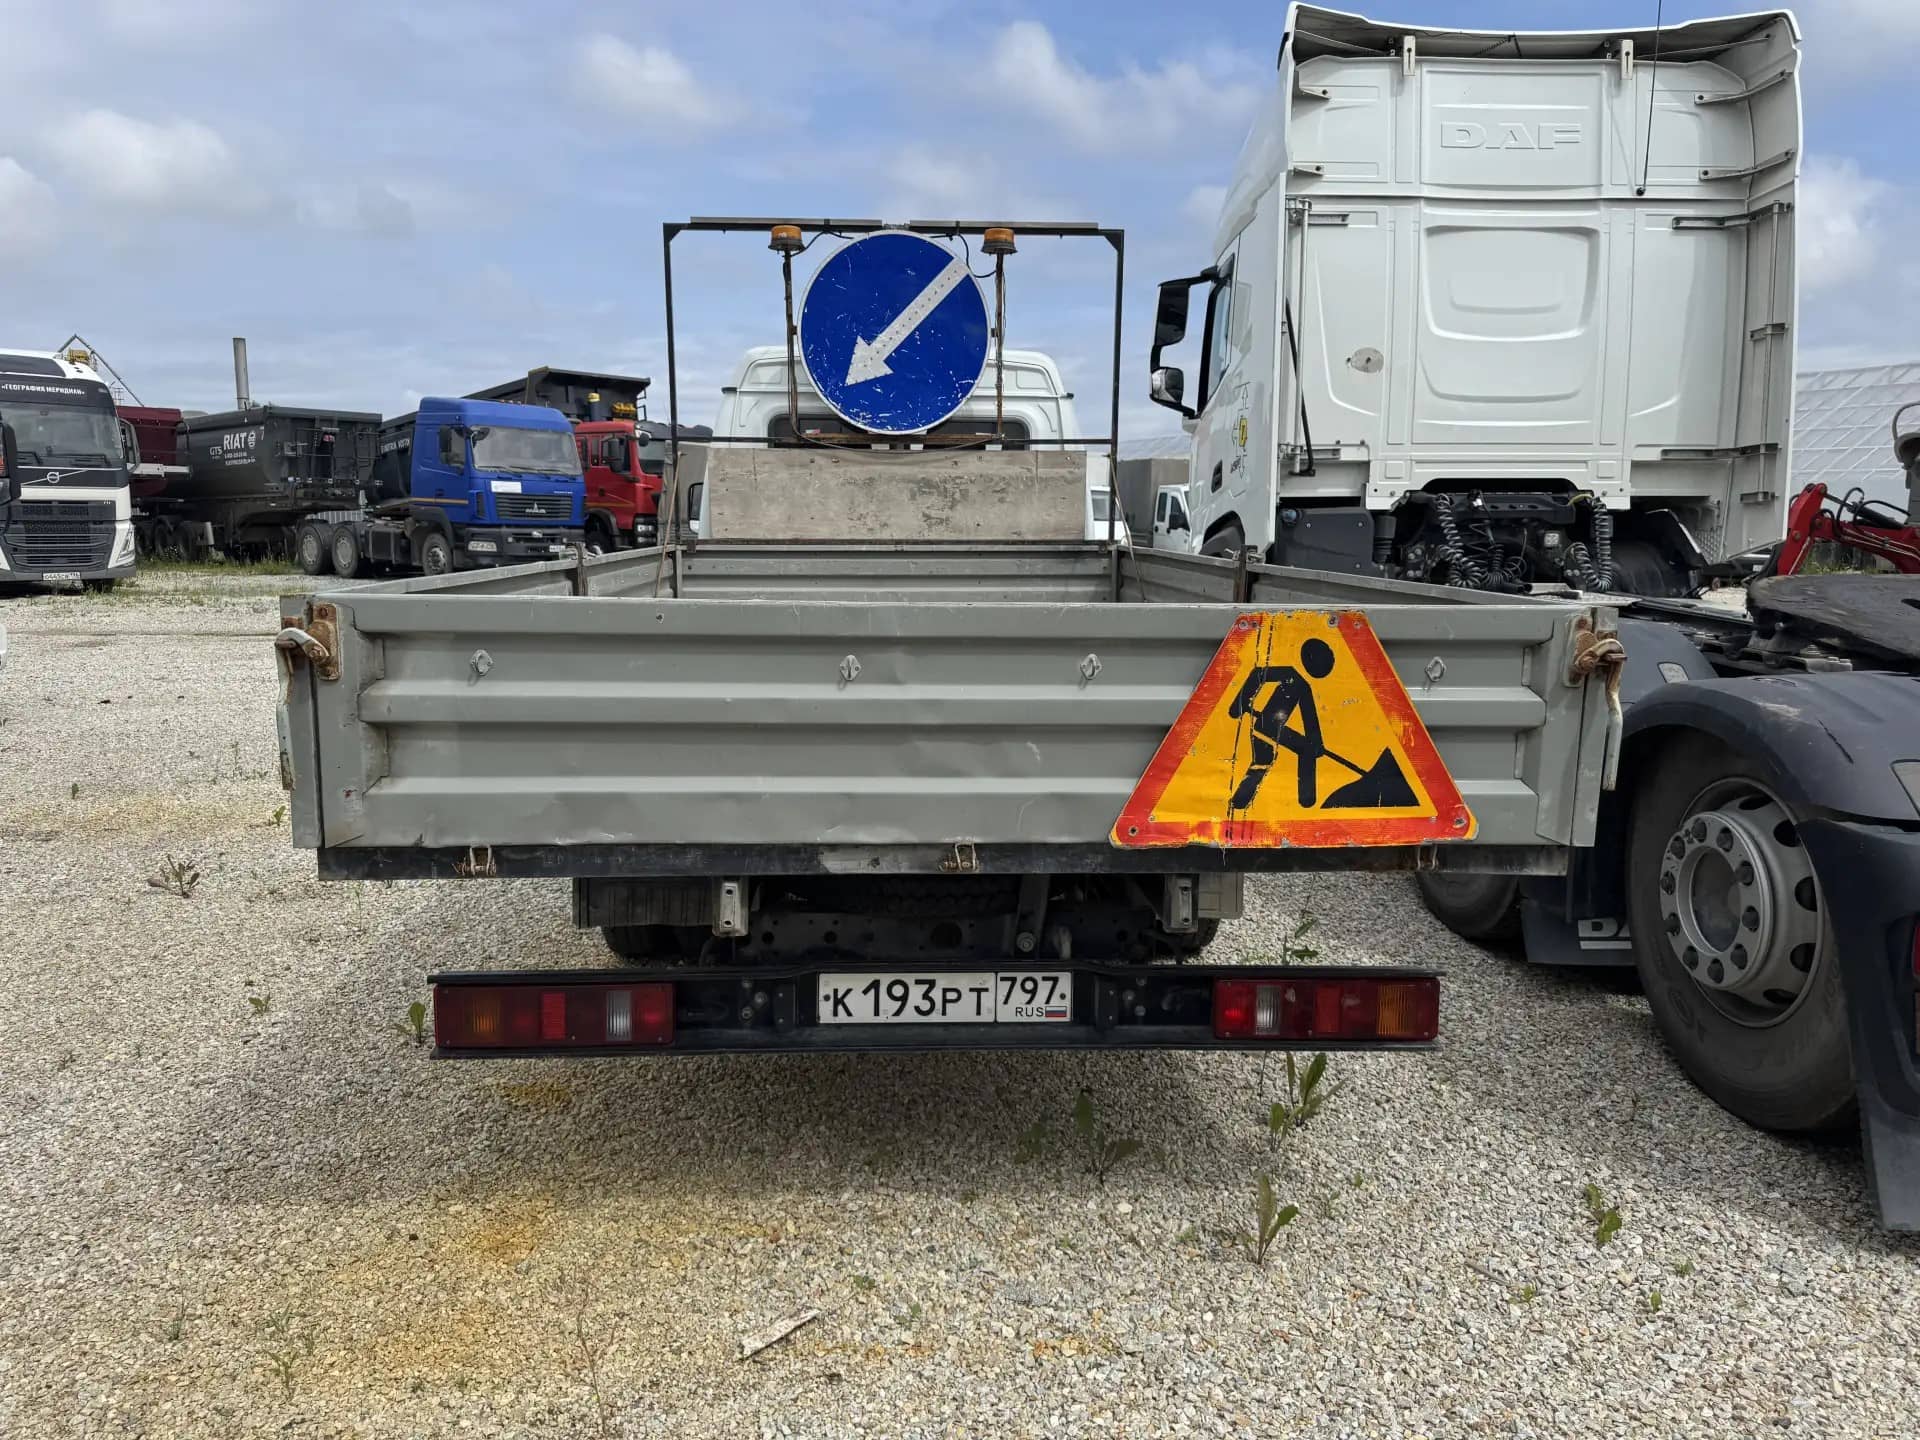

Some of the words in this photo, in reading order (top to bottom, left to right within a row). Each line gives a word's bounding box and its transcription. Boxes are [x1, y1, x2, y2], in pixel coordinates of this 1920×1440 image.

[1440, 121, 1582, 150] DAF
[223, 432, 247, 451] RIAT
[999, 976, 1060, 1005] 797
[1015, 1006, 1044, 1017] RUS
